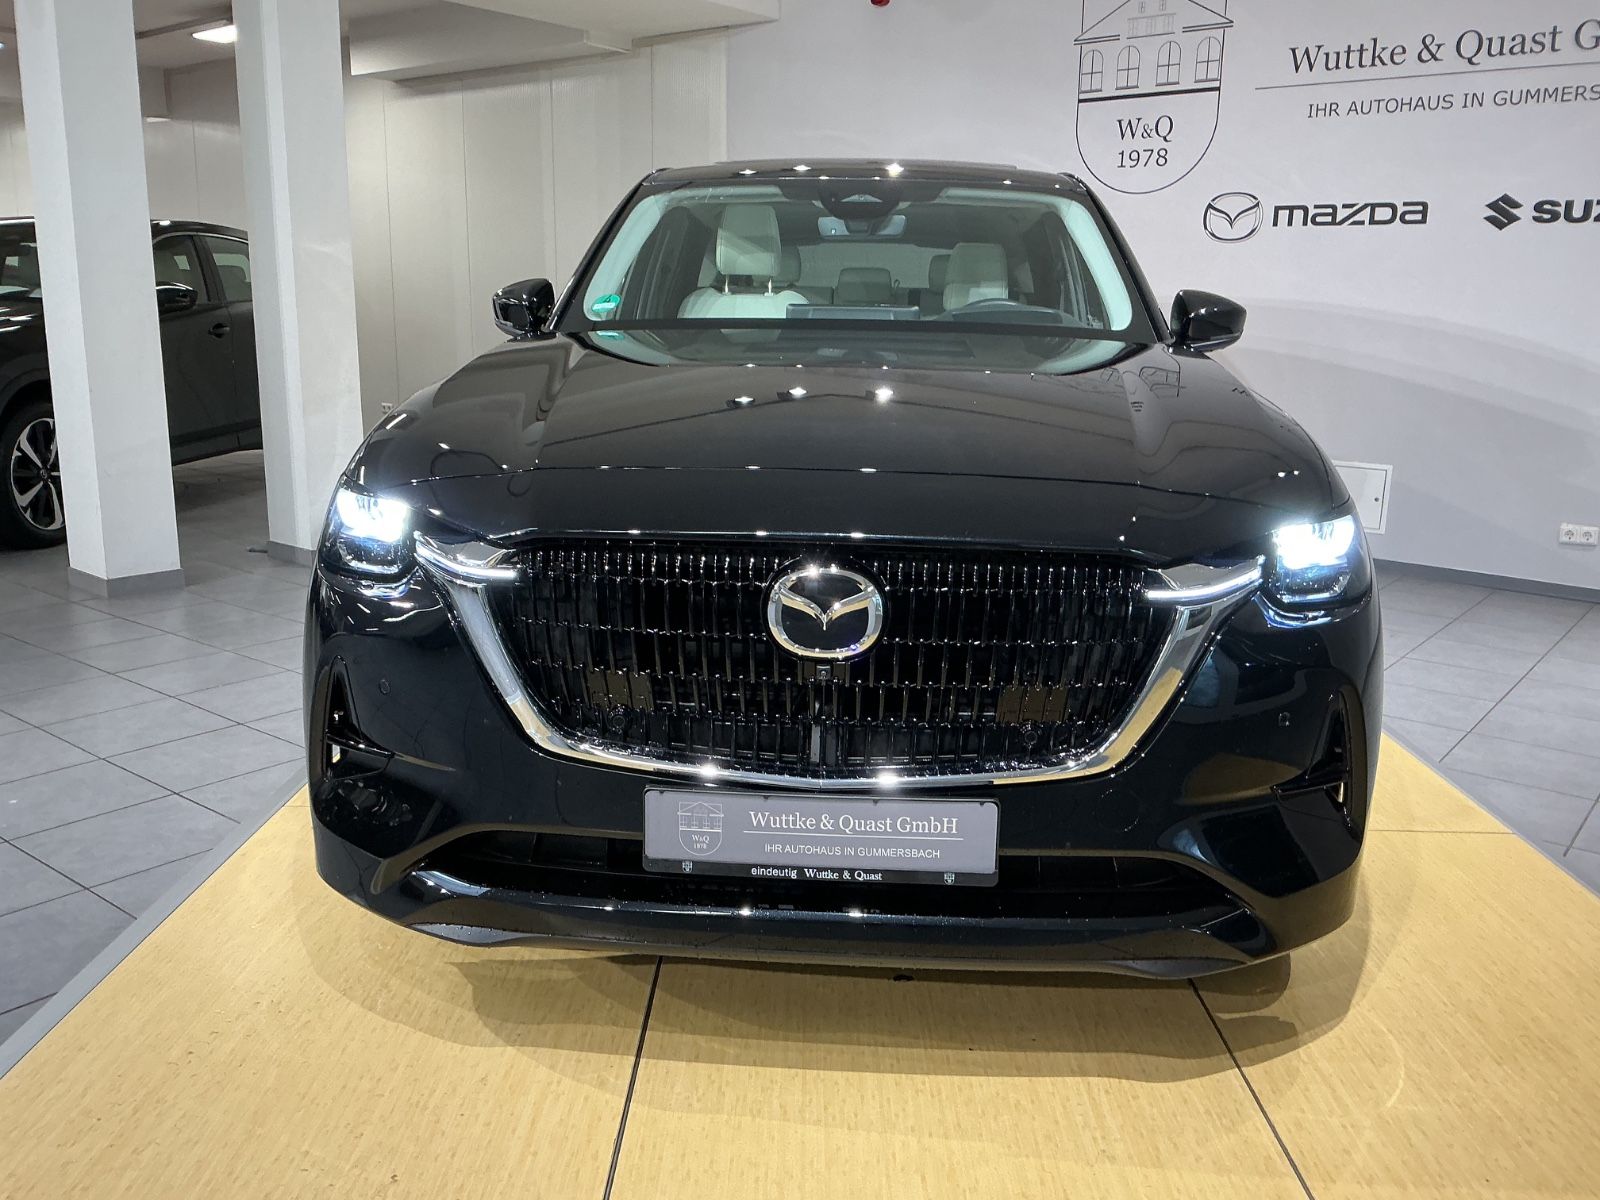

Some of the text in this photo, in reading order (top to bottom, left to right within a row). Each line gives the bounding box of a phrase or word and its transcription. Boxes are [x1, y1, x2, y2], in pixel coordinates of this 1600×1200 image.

[1289, 36, 1407, 74] Wuttke
[1416, 33, 1447, 64] &
[1455, 25, 1563, 66] Quast
[1307, 83, 1600, 119] IHR AUTOHAUS IN GUMMERS
[1116, 114, 1174, 143] W&Q
[1116, 147, 1169, 169] 1978
[1531, 198, 1600, 224] SU
[749, 811, 959, 835] Wuttke & Quast GmbH
[764, 843, 941, 859] IHR AUTOHAUS IN GUMMERSBACH
[751, 866, 883, 881] eindeutig Wuttke & Quast
